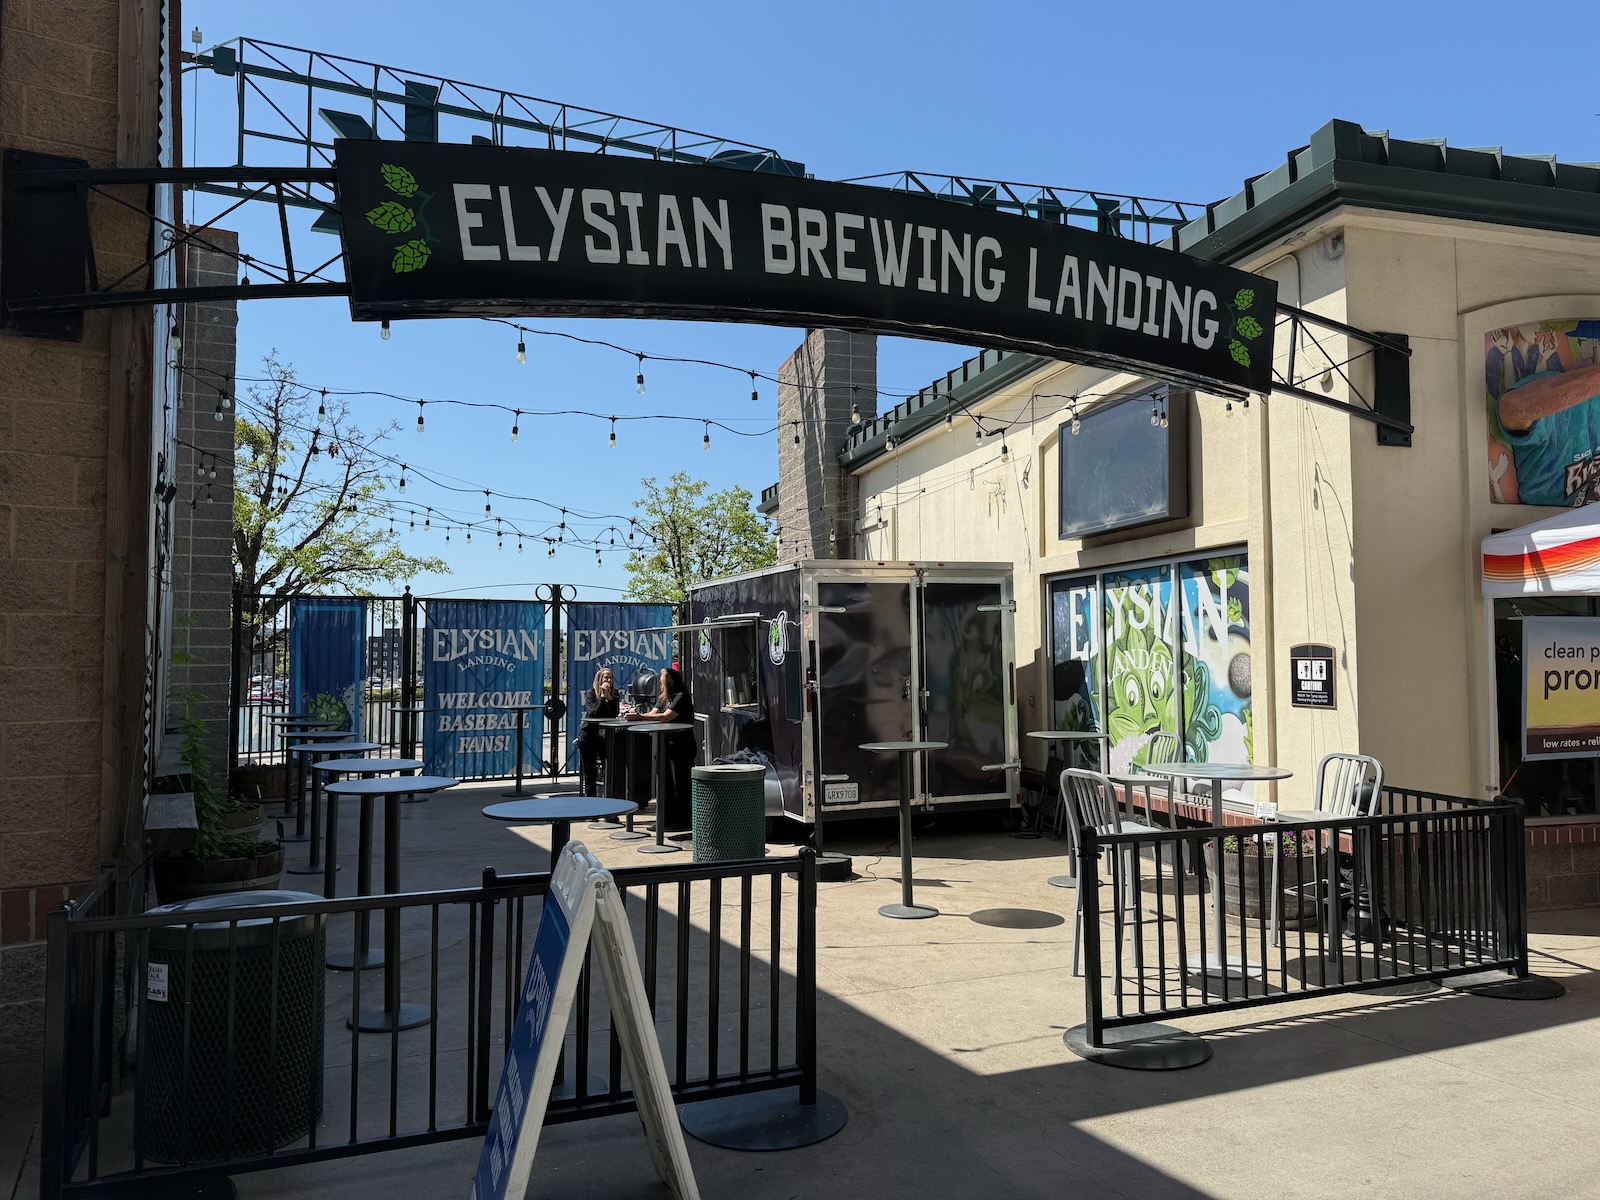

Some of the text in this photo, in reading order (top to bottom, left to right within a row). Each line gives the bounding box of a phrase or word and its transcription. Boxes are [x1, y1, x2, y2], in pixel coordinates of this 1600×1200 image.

[452, 183, 1220, 351] ELYSIAN BREWING LANDING
[1069, 568, 1229, 661] ELYSIAN
[433, 629, 538, 662] ELYSIAN
[574, 630, 667, 661] ELYSIAN
[1544, 641, 1585, 659] clean
[457, 656, 516, 673] LANDING
[438, 691, 532, 709] WELCOME
[437, 713, 530, 732] BASEBALL
[457, 735, 512, 753] FANS!
[1543, 738, 1559, 749] low
[1560, 738, 1580, 748] rates
